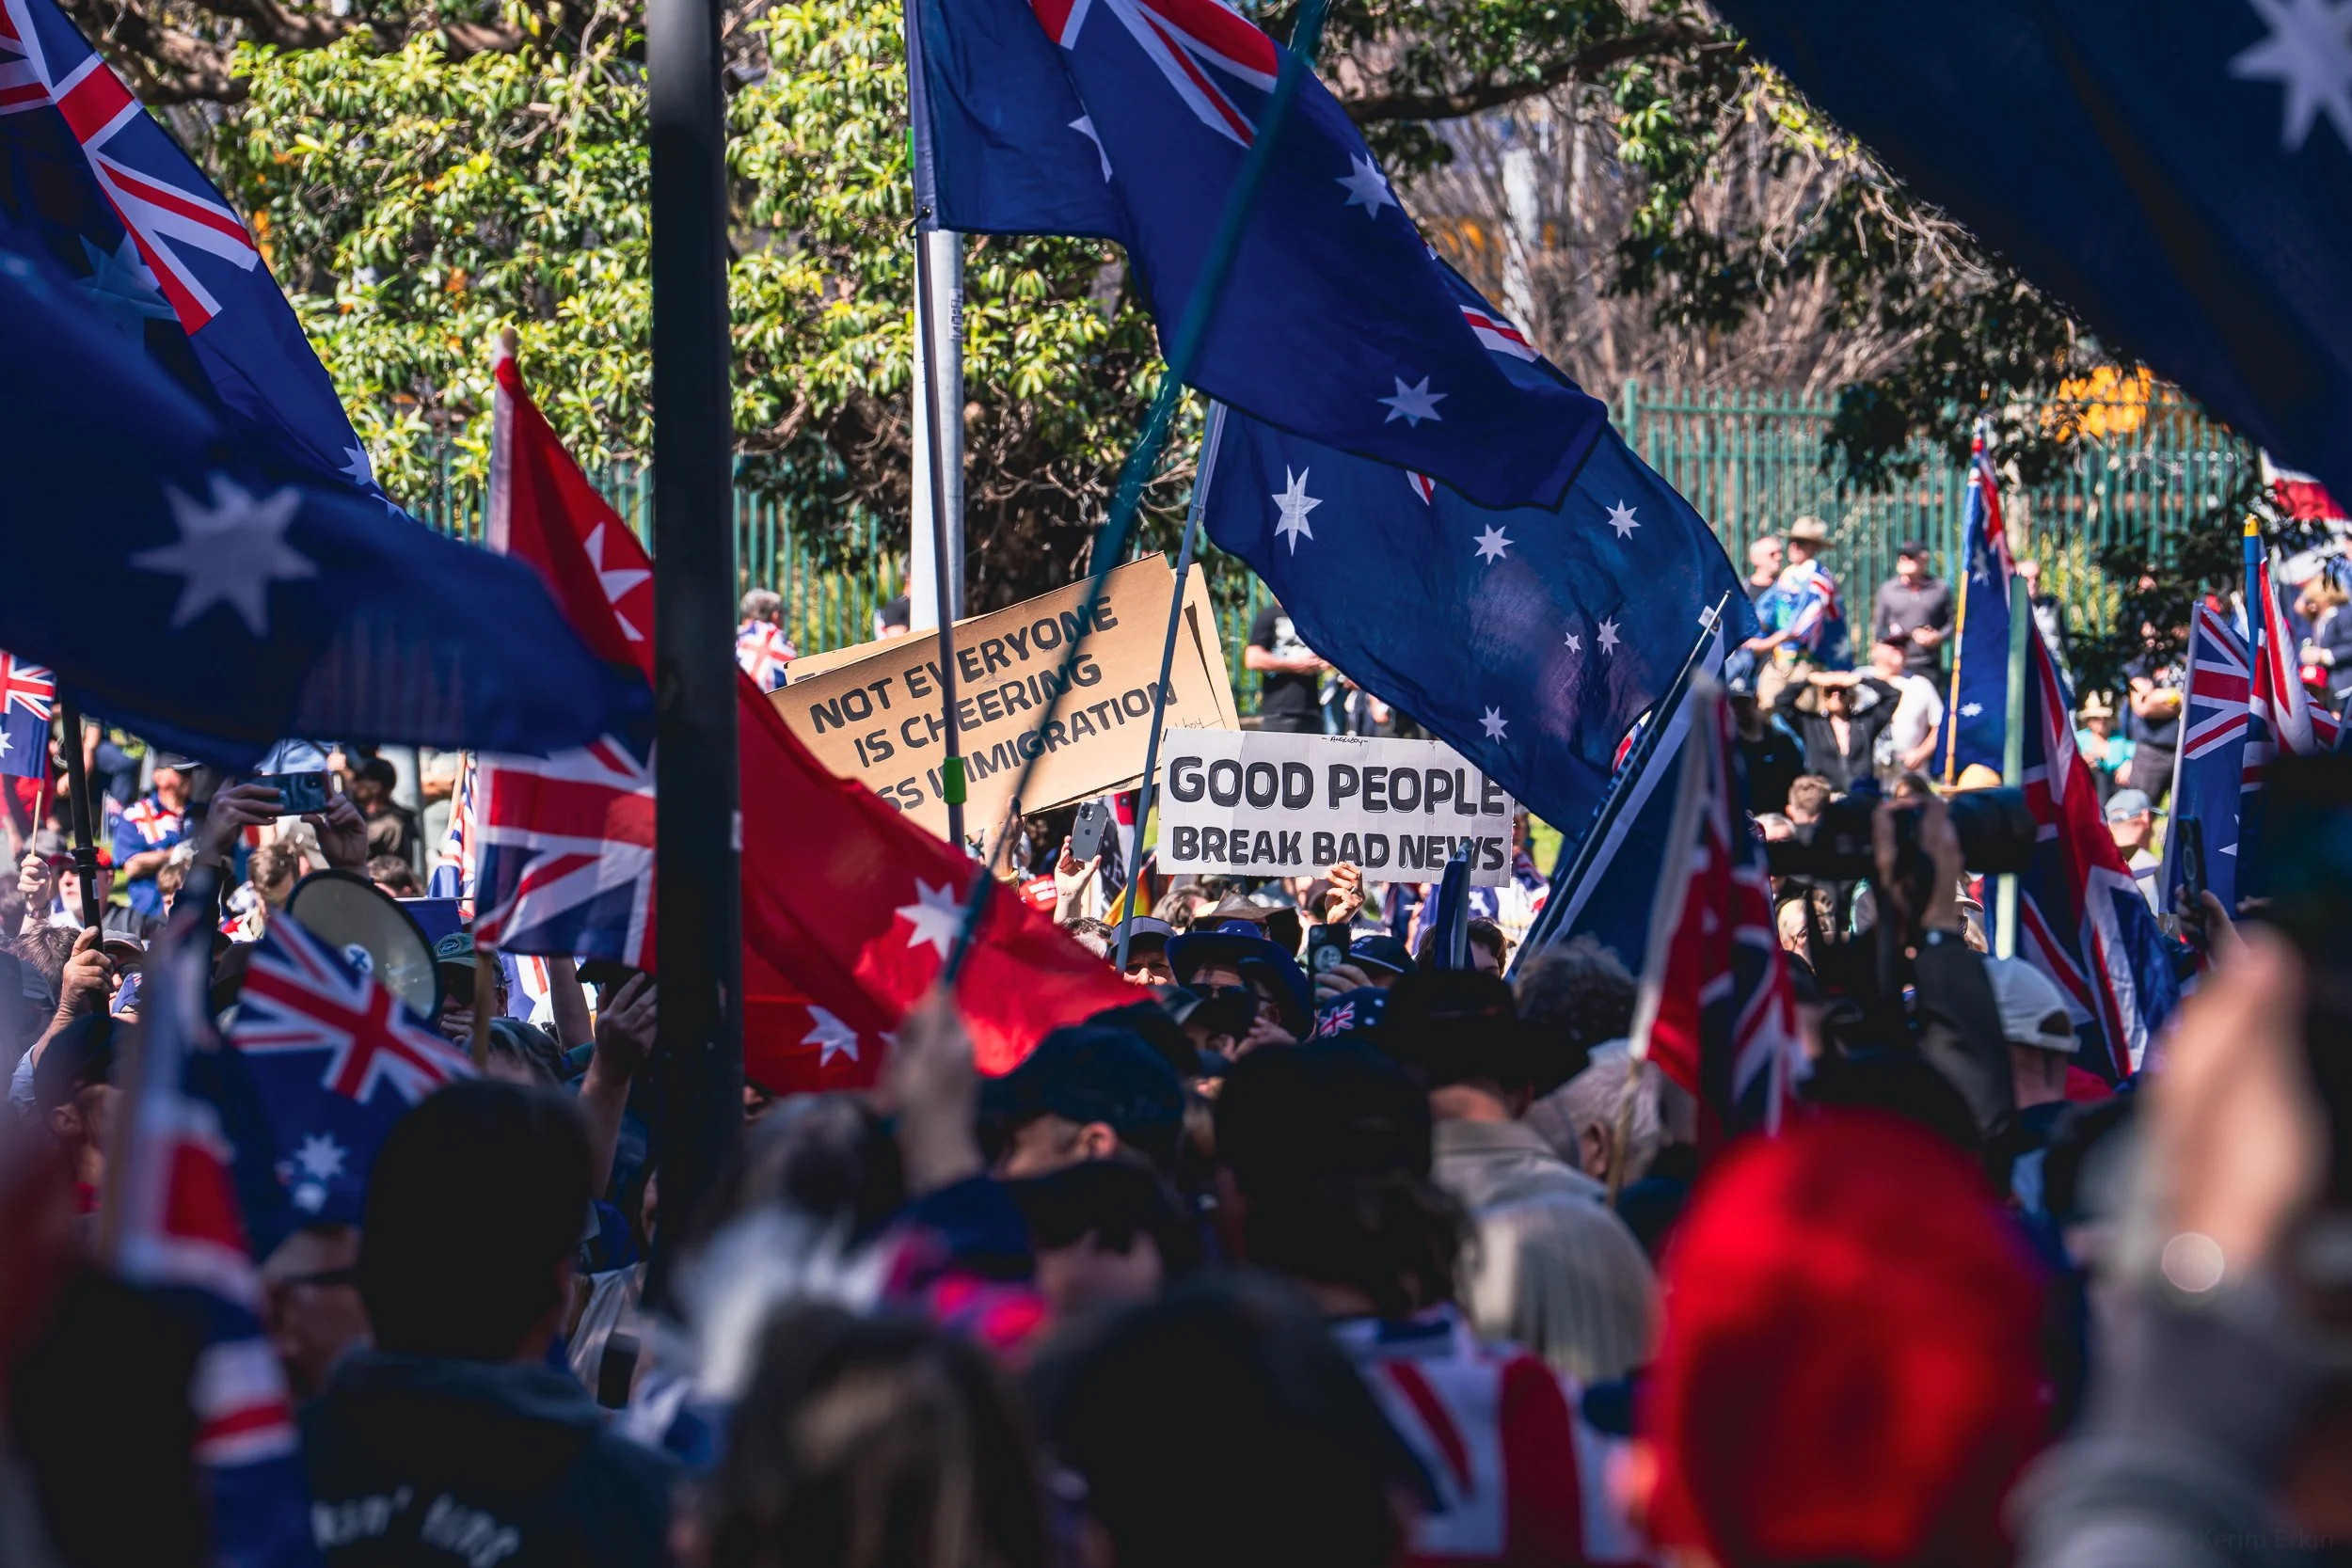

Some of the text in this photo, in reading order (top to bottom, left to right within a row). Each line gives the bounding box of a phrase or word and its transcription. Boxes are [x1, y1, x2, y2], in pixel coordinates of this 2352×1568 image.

[809, 676, 893, 735] NOT
[853, 728, 895, 768] IS
[1169, 755, 1505, 817] GOOD PEOPLE
[1171, 825, 1303, 866] BREAK
[1311, 832, 1391, 869] BAD
